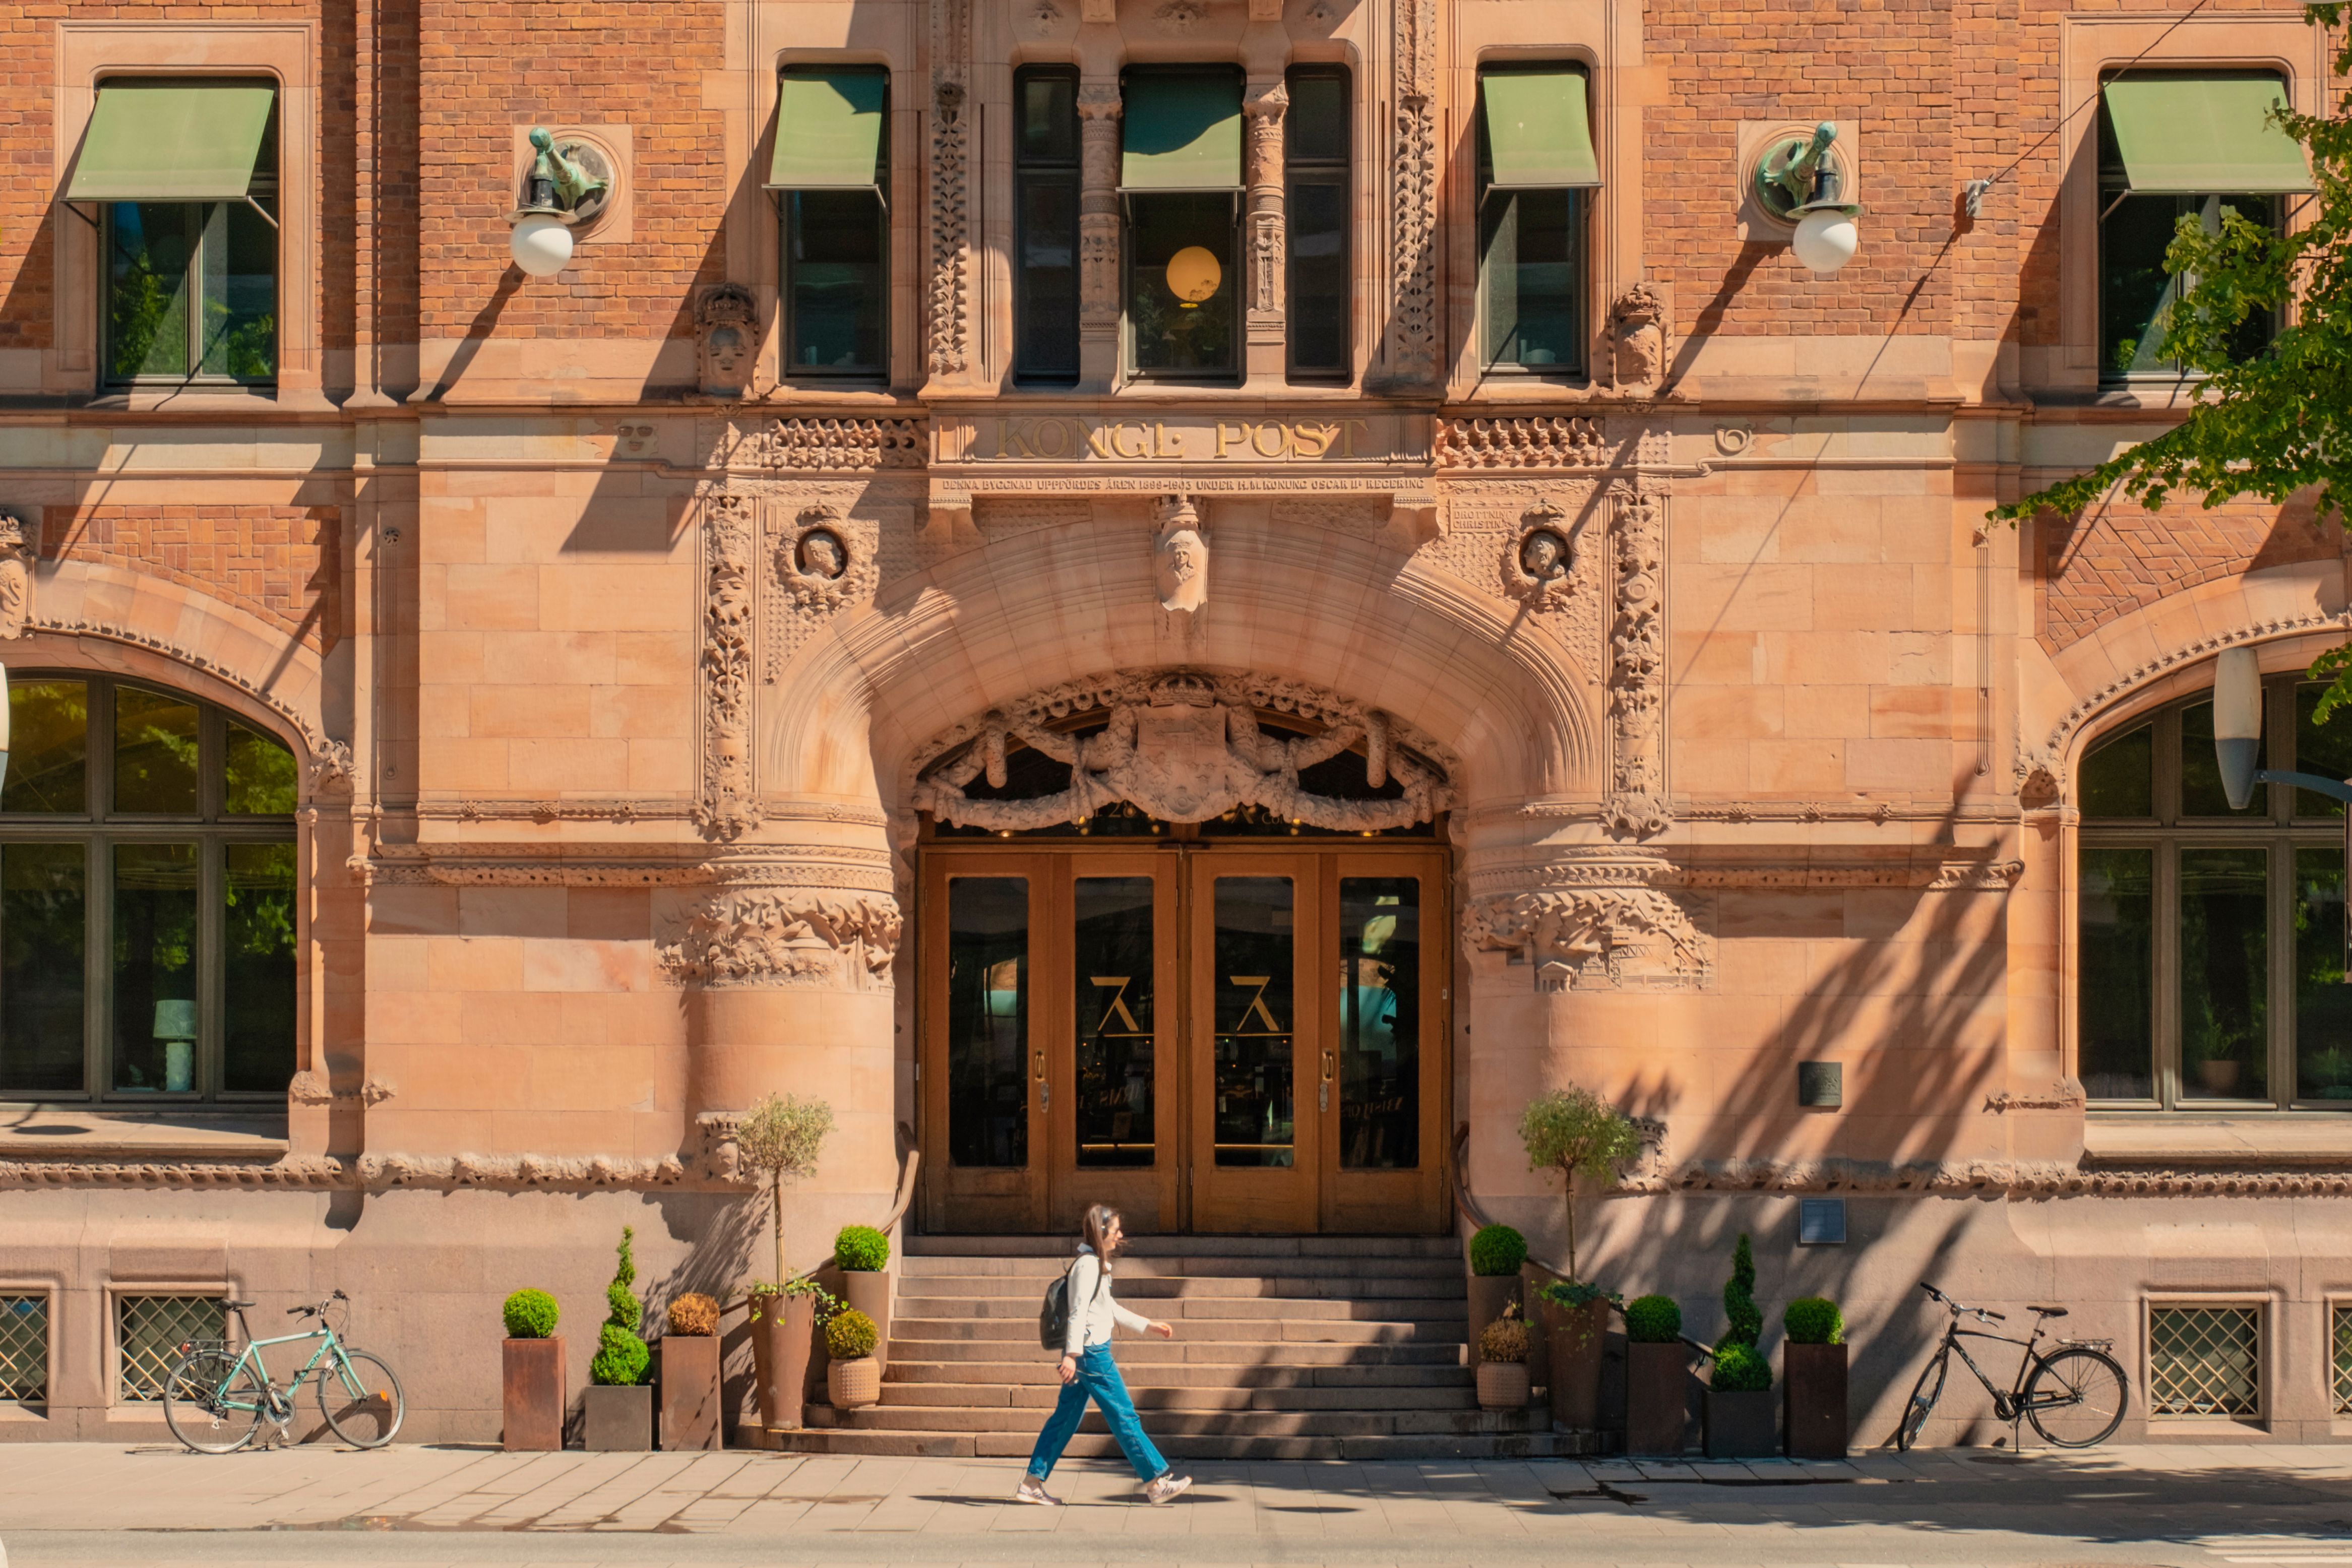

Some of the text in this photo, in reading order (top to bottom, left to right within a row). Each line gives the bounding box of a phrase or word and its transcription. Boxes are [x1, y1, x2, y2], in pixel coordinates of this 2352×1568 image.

[1214, 419, 1368, 459] POST
[943, 480, 979, 490] DENNA
[982, 480, 1033, 490] BYGGNAD
[1037, 478, 1101, 490] UPPFÖRDES
[1105, 477, 1136, 490] ÅREN
[1196, 480, 1234, 490] UNDER
[1263, 480, 1307, 490] KONUNG
[1311, 480, 1348, 490] OSCAR
[1366, 479, 1424, 489] REGERING
[1453, 520, 1508, 529] CHRISTIN
